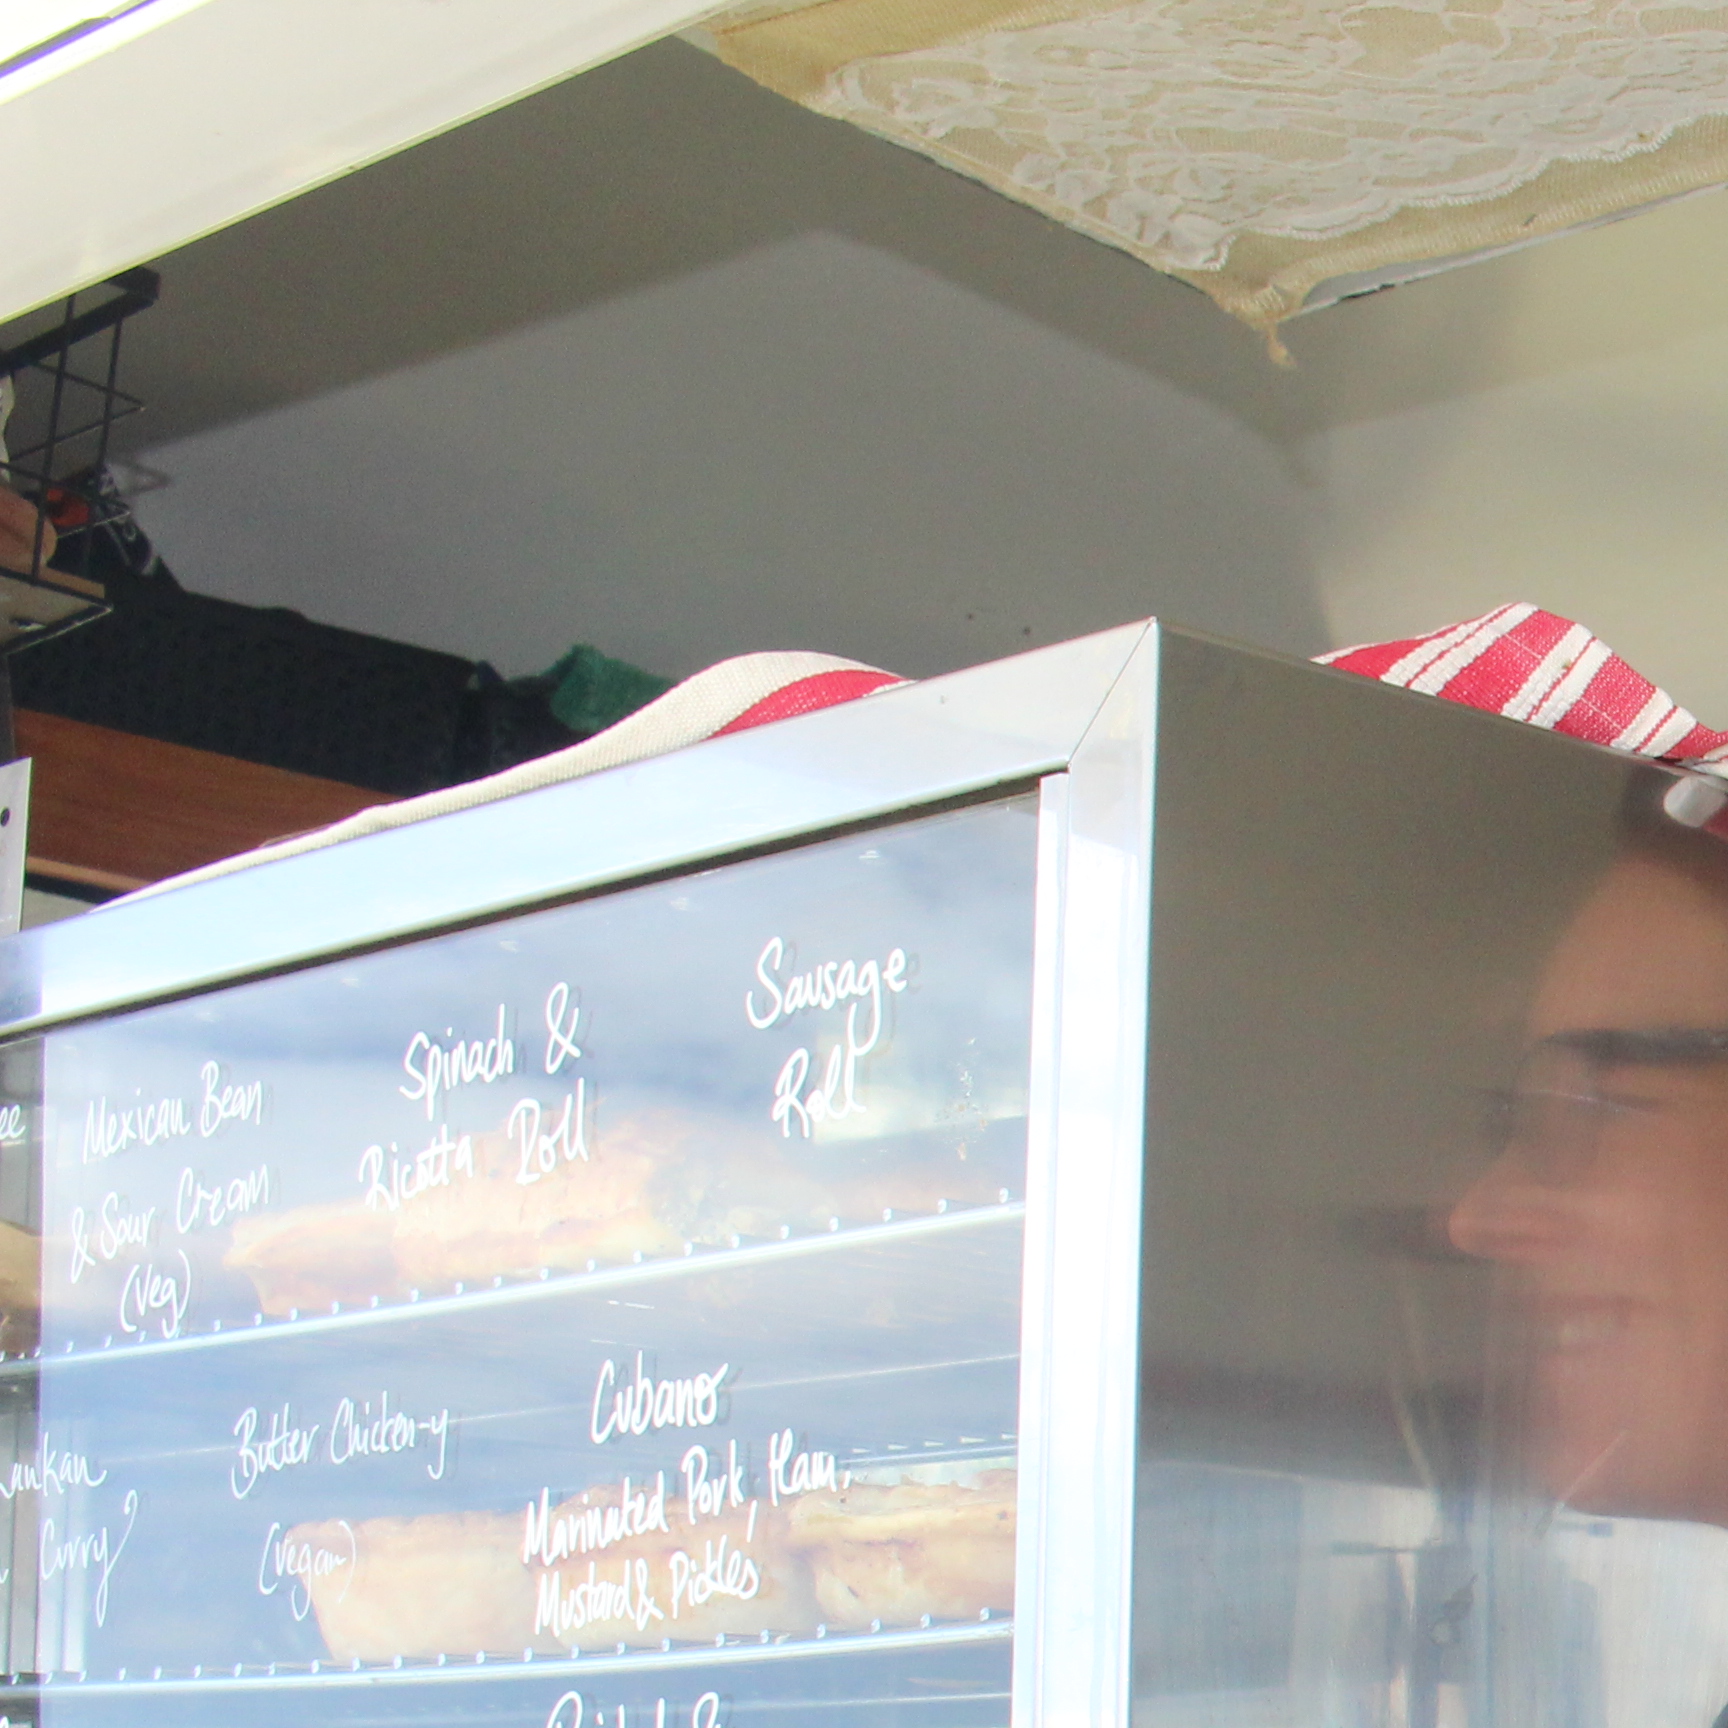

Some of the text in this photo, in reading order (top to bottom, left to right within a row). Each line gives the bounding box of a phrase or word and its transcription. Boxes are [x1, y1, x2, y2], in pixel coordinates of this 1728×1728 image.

[746, 936, 907, 1057] Sausage
[400, 981, 582, 1119] Spinach &
[772, 1047, 866, 1138] Roll
[83, 1087, 191, 1164] Mexican
[201, 1059, 262, 1137] Bean
[358, 1077, 589, 1211] Ricotta Roll
[70, 1164, 270, 1284] & Sour Cream
[590, 1350, 730, 1444] Cubano
[231, 1403, 319, 1499] Butter
[523, 1470, 669, 1566] Marinated
[534, 1561, 637, 1637] Mustard
[670, 1548, 759, 1623] Pickles
